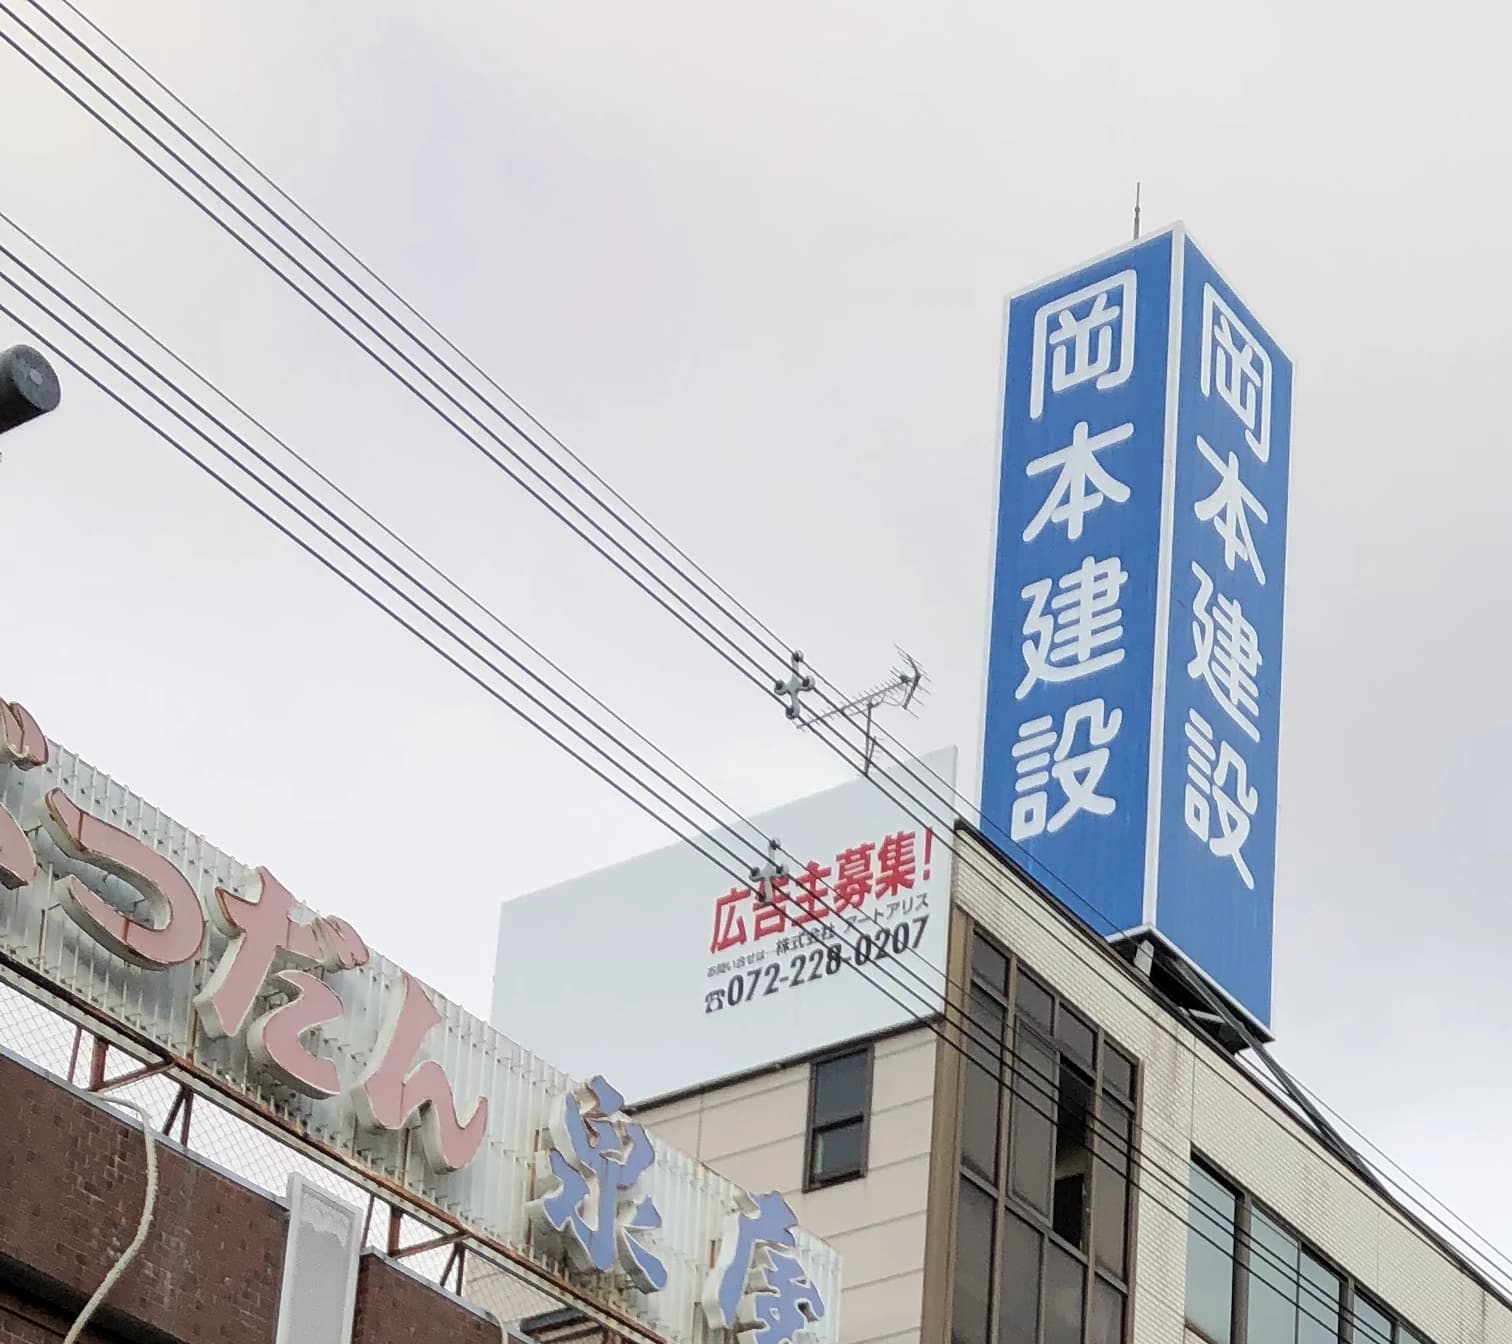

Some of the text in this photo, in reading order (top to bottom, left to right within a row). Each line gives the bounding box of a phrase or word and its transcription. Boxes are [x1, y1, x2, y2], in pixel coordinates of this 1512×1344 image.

[1011, 268, 1137, 840] 岡本建設
[1184, 281, 1272, 889] 岡本建設
